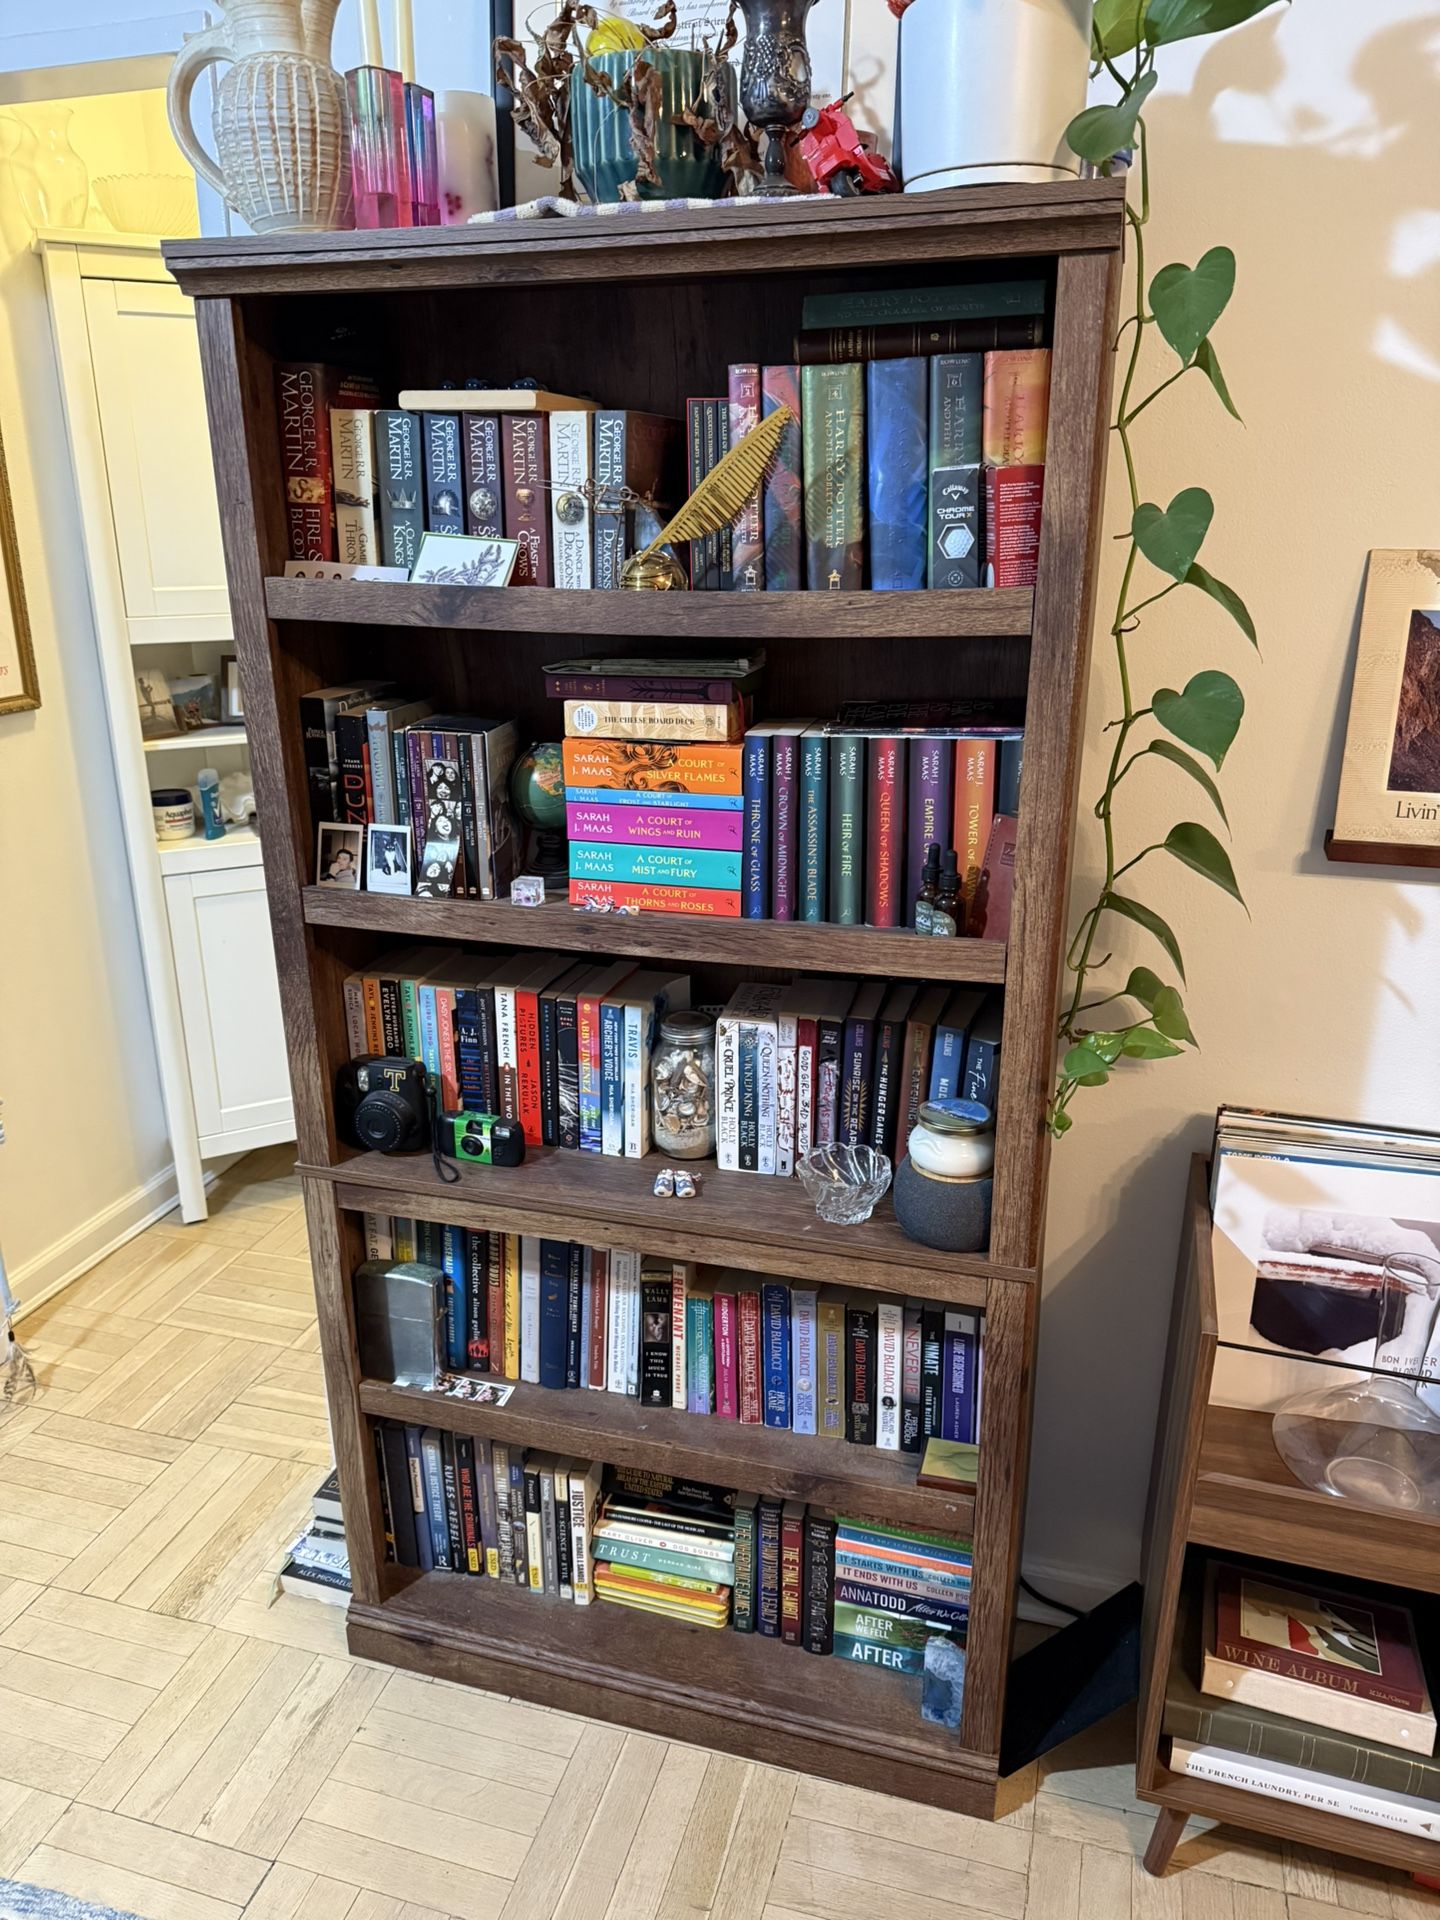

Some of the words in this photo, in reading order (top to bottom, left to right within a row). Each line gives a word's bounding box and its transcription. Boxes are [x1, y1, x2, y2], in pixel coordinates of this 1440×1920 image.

[280, 372, 303, 470] MARTIN
[300, 371, 316, 436] GEORGE
[339, 418, 353, 479] MARTIN
[354, 420, 363, 459] GEORGE
[388, 417, 402, 480] MARTIN
[402, 418, 411, 459] GEORGE
[431, 420, 445, 483] MARTIN
[445, 420, 456, 460] GEORGE
[470, 420, 484, 483] MARTIN
[484, 420, 496, 460] GEORGE
[512, 420, 526, 484] MARTIN
[527, 420, 537, 461] GEORGE
[557, 423, 571, 488] MARTIN
[571, 423, 581, 466] GEORGE
[600, 420, 612, 486] MARTIN
[613, 420, 623, 463] GEORGE
[835, 409, 844, 475] HARRY
[306, 508, 321, 545] FIRE
[836, 483, 845, 547] POTTER
[937, 505, 975, 514] CHROME
[393, 524, 405, 564] KINGS
[405, 528, 414, 560] CLASH
[518, 530, 529, 577] CROWS
[530, 535, 540, 565] FEAST
[564, 531, 575, 589] DRAGONS
[575, 539, 584, 573] DANCE
[603, 529, 613, 589] DRAGONS
[573, 754, 609, 763] SARAH
[582, 767, 612, 777] MAAS
[684, 772, 725, 783] FLAMES
[576, 812, 610, 822] SARAH
[583, 824, 613, 834] MAAS
[751, 798, 761, 844] THRONE
[842, 813, 852, 839] HEIR
[880, 792, 890, 832] QUEEN
[924, 798, 934, 839] EMPIRE
[968, 803, 979, 845] TOWER
[676, 829, 700, 839] RUIN
[577, 850, 611, 860] SARAH
[583, 862, 614, 872] MAAS
[632, 865, 655, 876] MIST
[671, 868, 697, 878] FURY
[777, 844, 787, 899] MIDNIGHT
[842, 855, 852, 877] FIRE
[751, 860, 760, 892] GLASS
[807, 869, 817, 900] BLADE
[880, 851, 889, 907] SHADOWS
[681, 901, 713, 912] ROSES
[382, 988, 391, 1022] EVELYN
[500, 993, 508, 1017] TANA
[385, 1023, 393, 1049] HUGO
[502, 1023, 510, 1059] FRENCH
[528, 1013, 536, 1050] HIDDEN
[581, 1018, 592, 1045] ABBY
[603, 1019, 613, 1057] ARCHER'S
[628, 1023, 638, 1058] TRAVIS
[582, 1048, 592, 1093] JIMENEZ
[604, 1059, 614, 1081] VOICE
[724, 1049, 734, 1078] CRUEL
[744, 1054, 752, 1092] WICKED
[852, 1052, 862, 1091] SUNRISE
[721, 1080, 735, 1112] PRINCE
[744, 1094, 752, 1117] KING
[877, 1077, 887, 1114] HUNGER
[740, 1120, 748, 1148] BLACK
[747, 1121, 755, 1148] HOLLY
[875, 1116, 885, 1144] GAMES
[444, 1231, 453, 1274] HOUSEMAID
[472, 1253, 482, 1294] collective
[673, 1278, 684, 1340] REVENANT
[721, 1298, 729, 1336] BRIDGERTON
[771, 1304, 781, 1329] DAVID
[800, 1310, 810, 1335] DAVID
[771, 1331, 782, 1370] BALDACCI
[799, 1337, 810, 1376] BALDACCI
[855, 1338, 866, 1363] DAVID
[884, 1327, 895, 1352] DAVID
[906, 1328, 918, 1373] NEVER
[745, 1346, 757, 1383] BALDACCI
[884, 1354, 895, 1394] BALDACCI
[924, 1342, 939, 1376] INMATE
[855, 1364, 866, 1401] BALDACCI
[444, 1465, 456, 1498] RULES
[572, 1490, 585, 1528] JUSTICE
[448, 1509, 459, 1549] REBELS
[464, 1513, 475, 1548] CRIMINALS
[559, 1520, 568, 1552] SCIENCE
[762, 1524, 778, 1539] THE
[599, 1544, 651, 1563] TRUST
[735, 1541, 751, 1588] INHERITANCE
[762, 1541, 778, 1591] HAWTHORNE
[783, 1546, 799, 1562] THE
[298, 1569, 315, 1578] ALEX
[782, 1564, 798, 1587] FINAL
[854, 1570, 878, 1581] ENDS
[880, 1575, 904, 1587] WITH
[906, 1581, 918, 1590] US
[736, 1589, 750, 1616] GAMES
[761, 1592, 777, 1624] LEGACY
[783, 1590, 798, 1620] GAMBIT
[856, 1614, 893, 1631] AFTER
[852, 1643, 903, 1668] AFTER
[1223, 1644, 1280, 1672] WINE
[1286, 1663, 1359, 1694] ALBUM
[1185, 1763, 1205, 1773] THE
[1208, 1767, 1248, 1784] FRENCH
[1304, 1792, 1324, 1804] PER
[1327, 1799, 1340, 1808] SE
